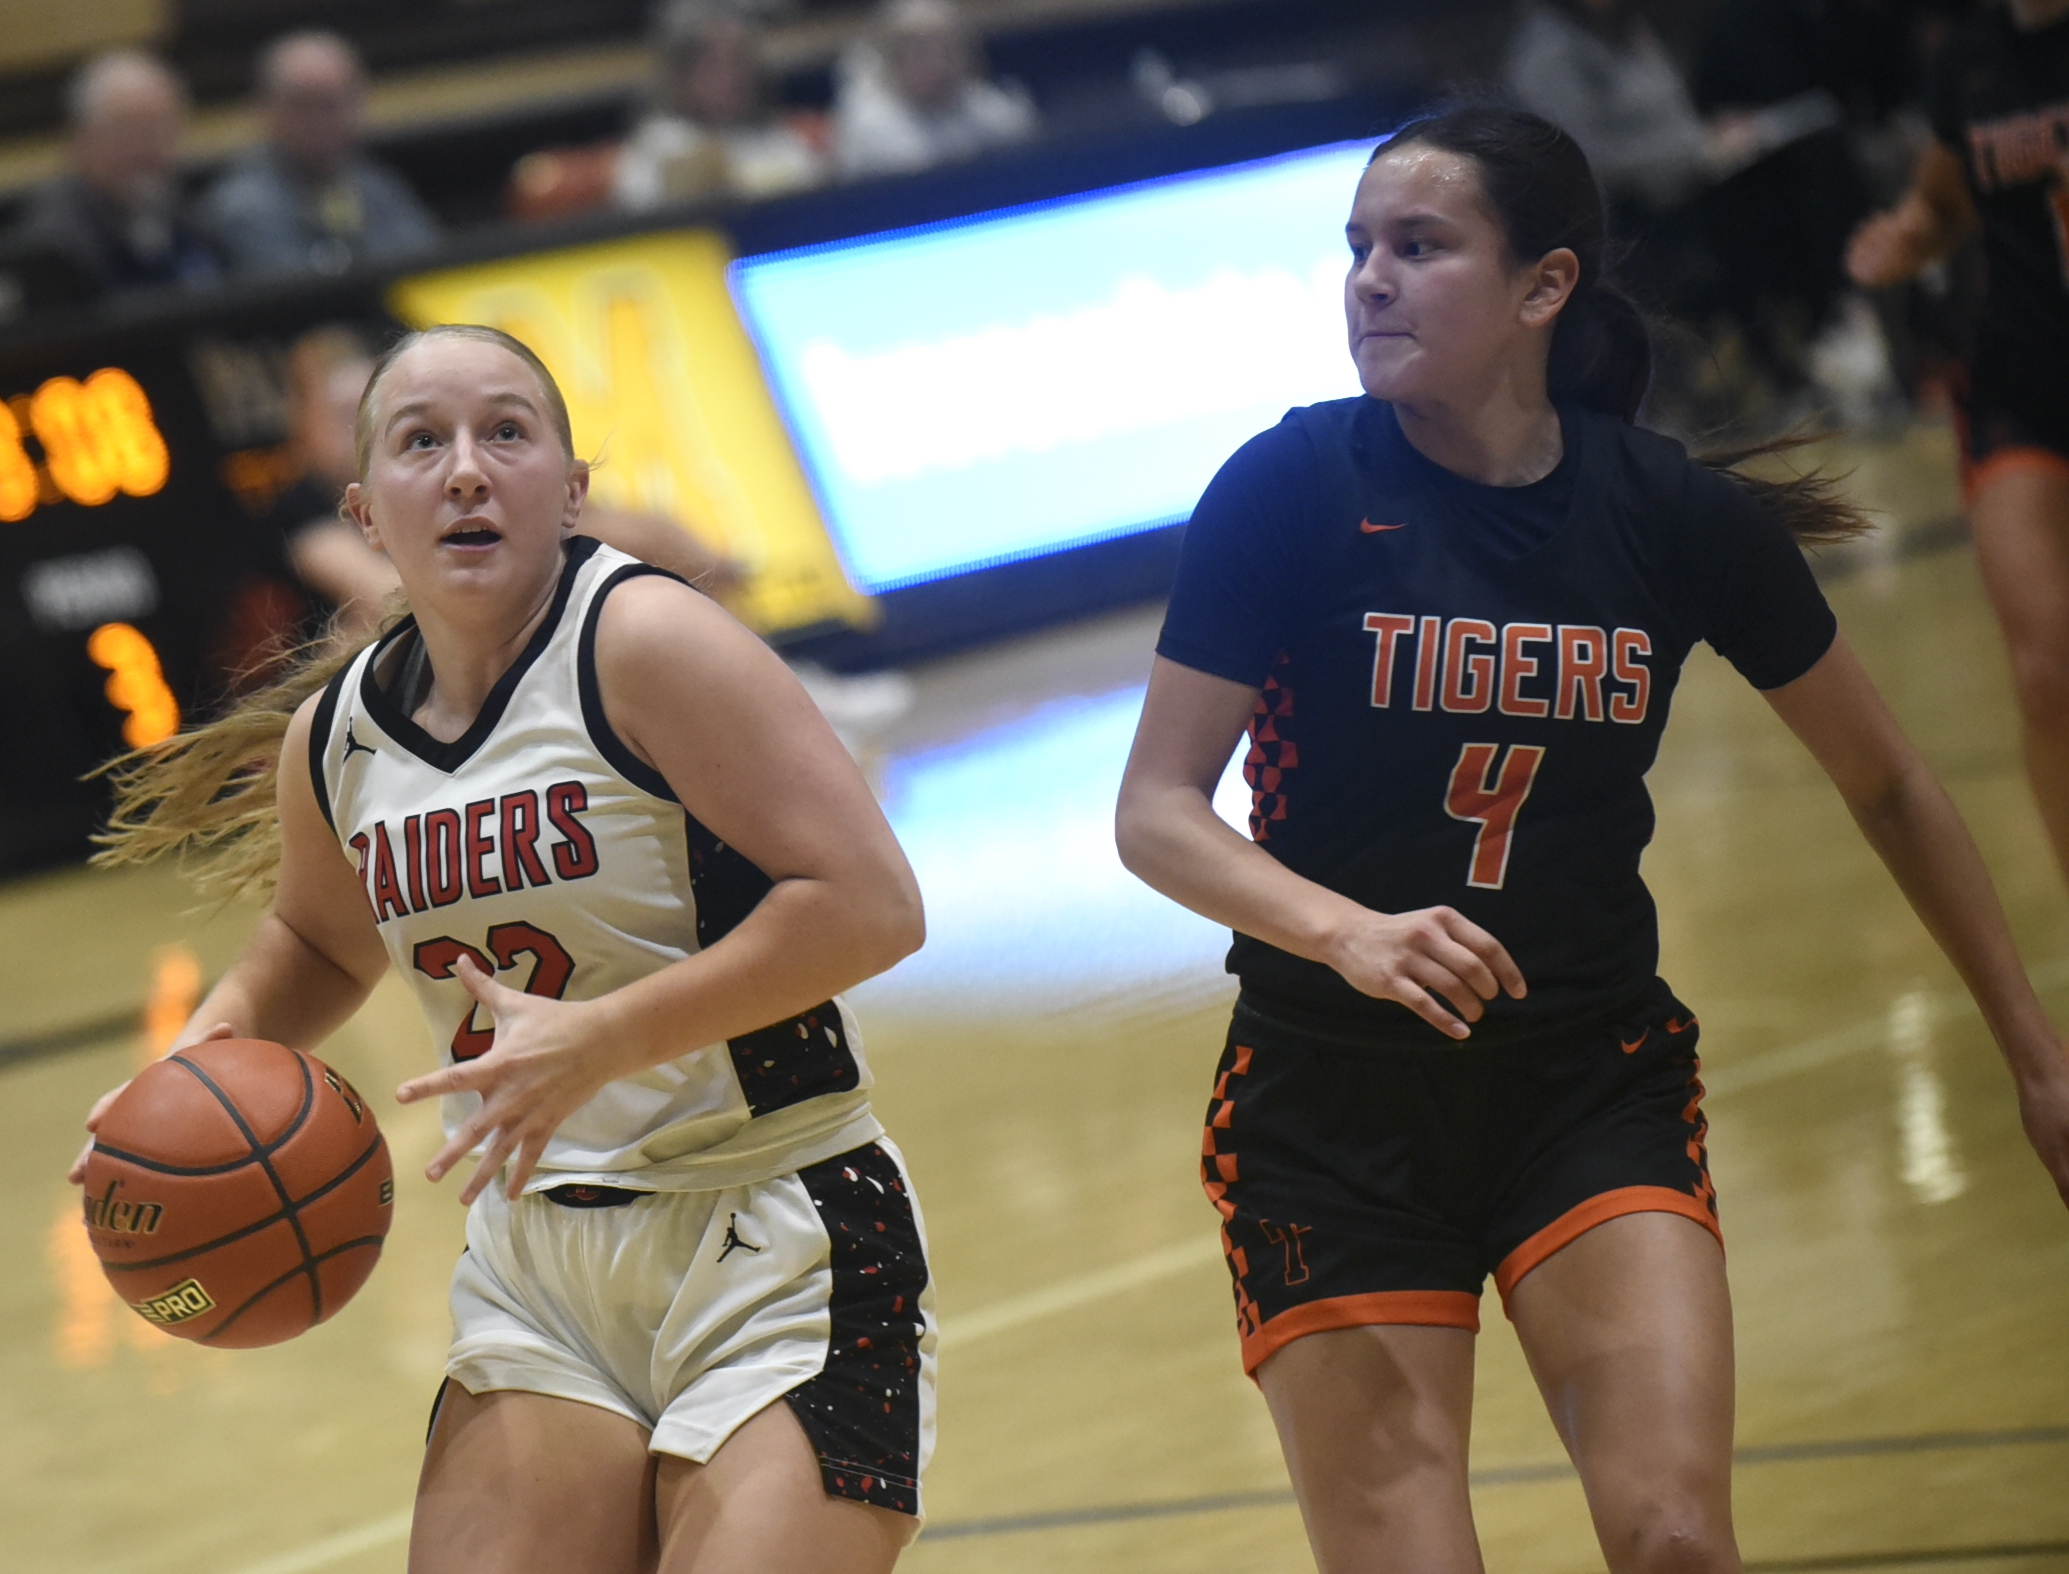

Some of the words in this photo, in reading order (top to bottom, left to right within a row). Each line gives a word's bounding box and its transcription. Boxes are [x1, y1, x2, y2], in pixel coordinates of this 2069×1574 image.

[1362, 612, 1652, 724] TIGERS
[1443, 743, 1546, 890] 4
[84, 1179, 164, 1234] den
[152, 1285, 208, 1322] PRO
